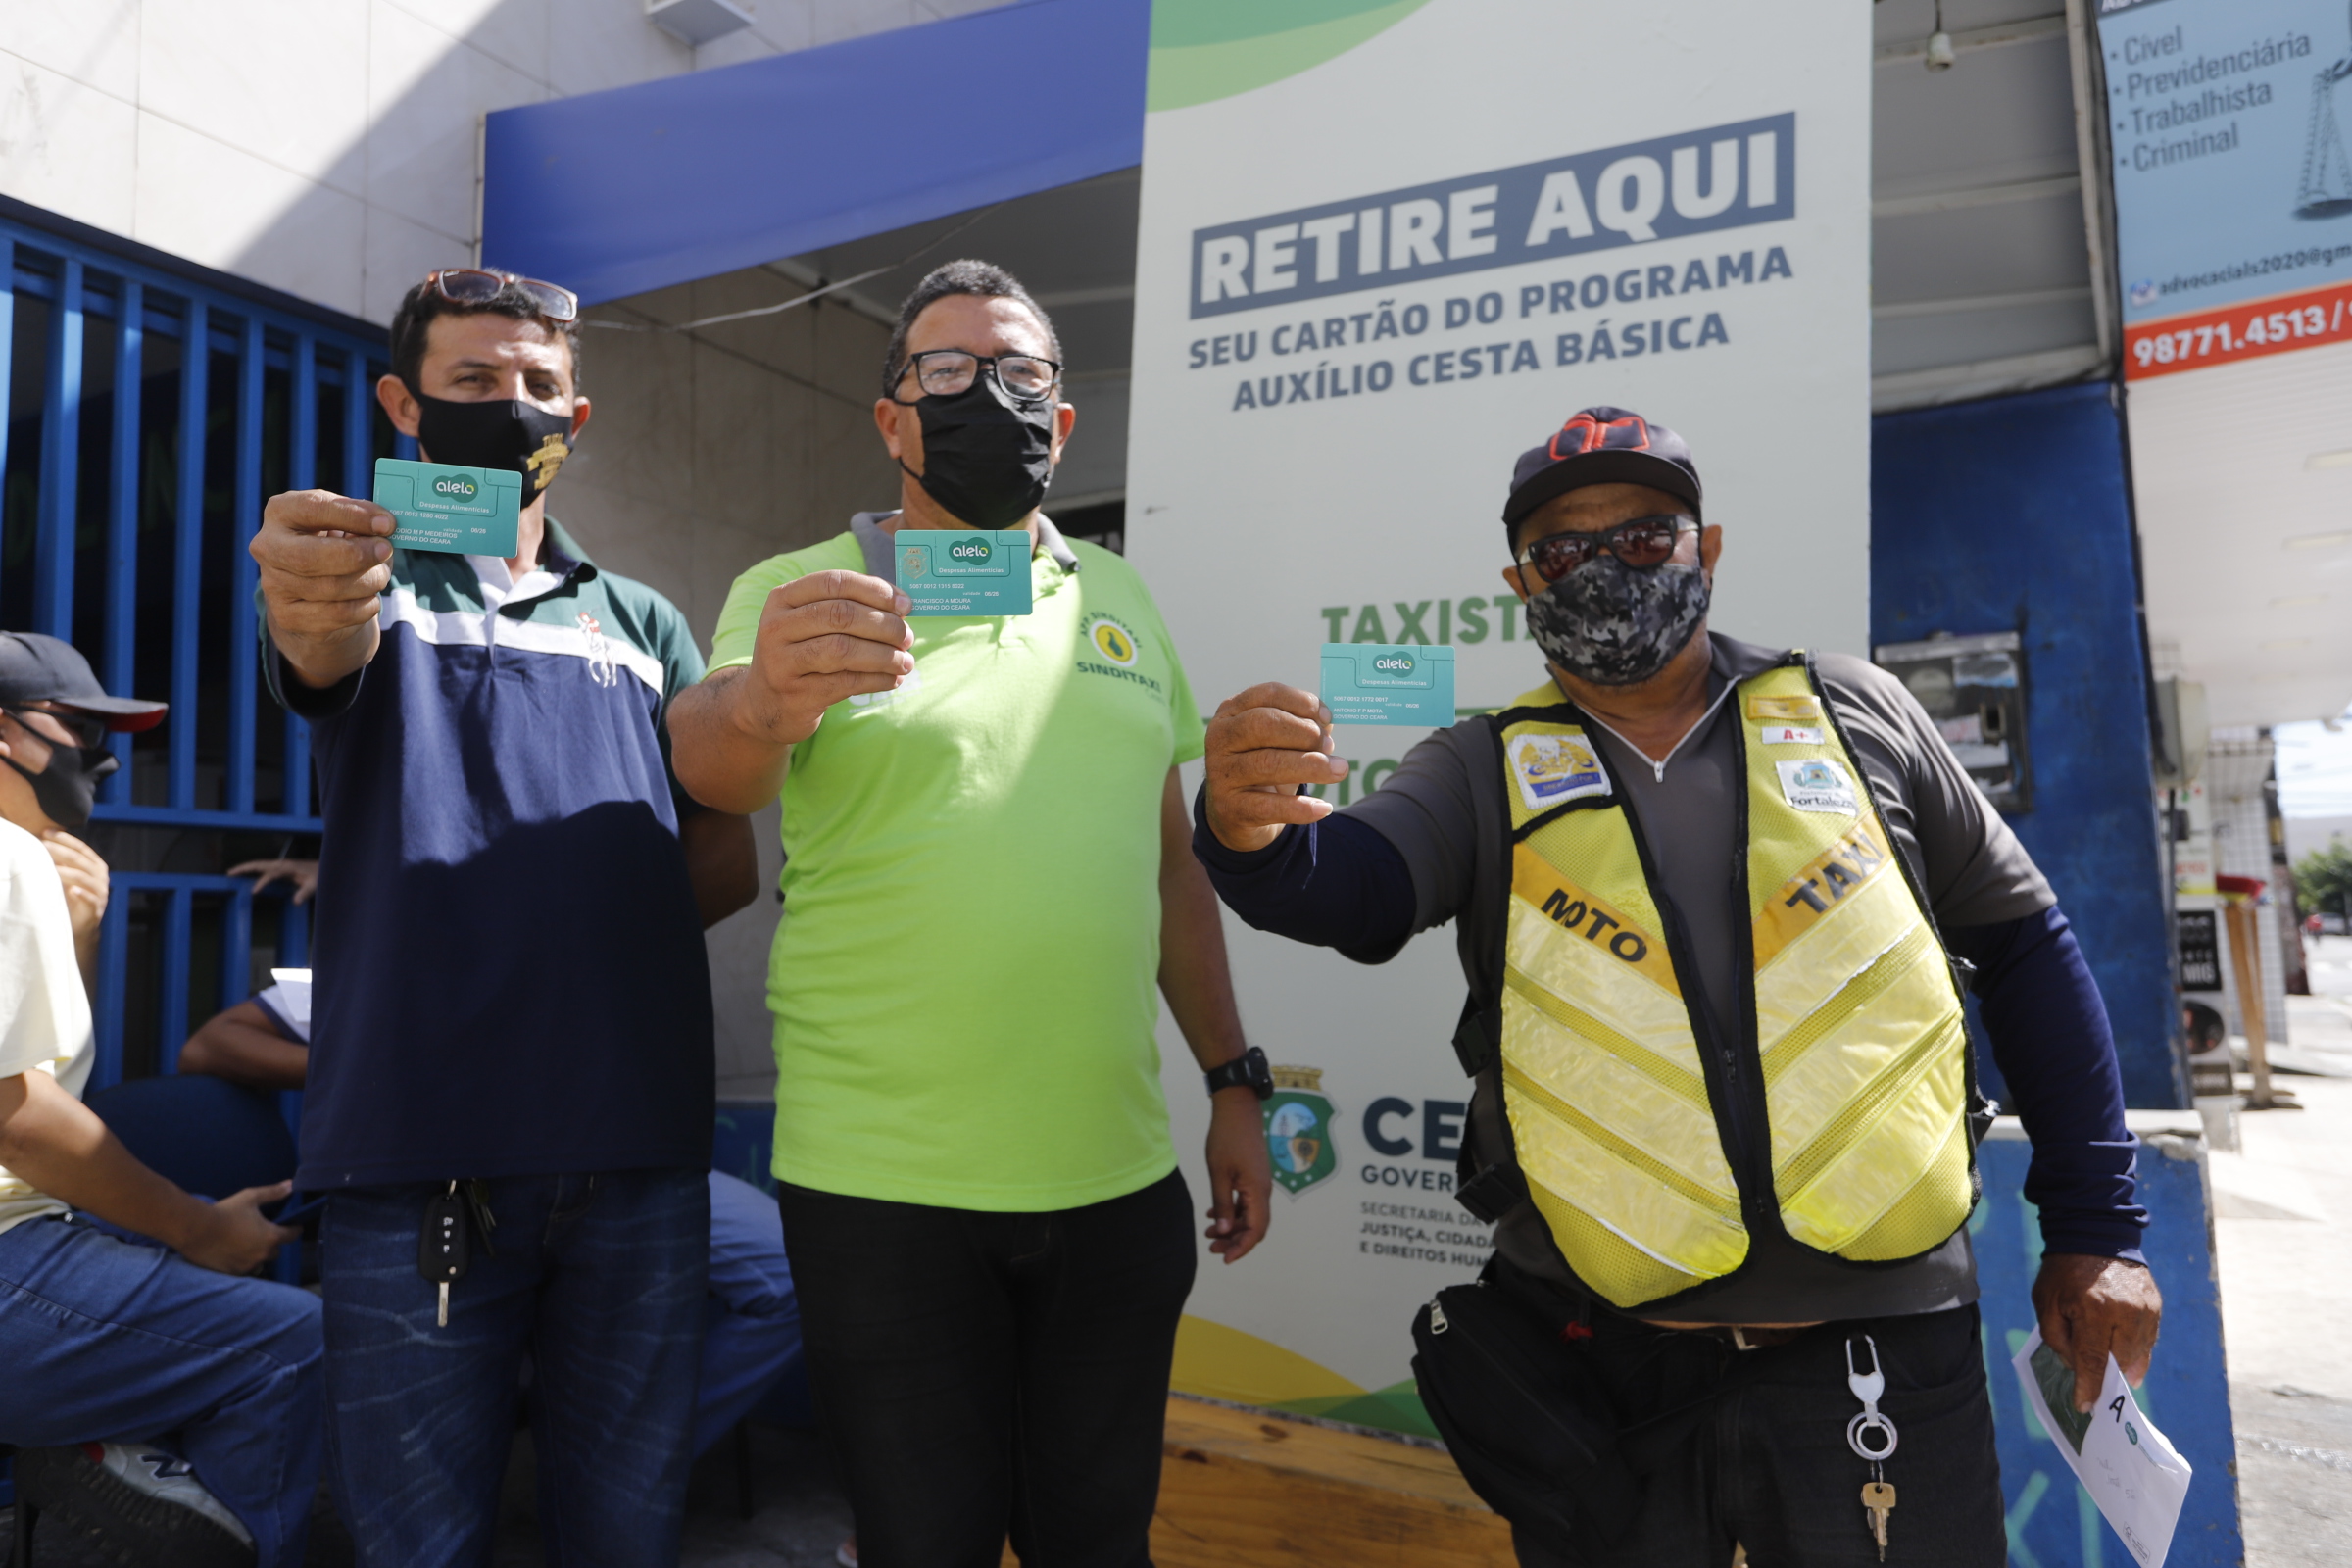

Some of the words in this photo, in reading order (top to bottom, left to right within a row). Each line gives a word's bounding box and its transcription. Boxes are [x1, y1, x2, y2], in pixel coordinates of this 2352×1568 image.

[2124, 24, 2183, 66] Cível
[2128, 30, 2311, 100] Previdenciária
[2132, 81, 2272, 135] Trabalhista
[2133, 122, 2239, 172] Criminal
[1200, 184, 1499, 304] RETIRE
[1524, 130, 1777, 243] AQUI
[2160, 244, 2352, 295] advocacials2020@gm
[1189, 329, 1257, 369] SEU
[1271, 299, 1429, 356] CARTÃO
[1444, 290, 1504, 330] DO
[1519, 245, 1794, 318] PROGRAMA
[2133, 305, 2326, 368] 98771.4513
[1231, 360, 1394, 412] AUXÍLIO
[1408, 338, 1541, 386] CESTA
[1556, 312, 1730, 367] BÁSICA
[419, 501, 450, 512] Despesas
[436, 480, 474, 495] alelo
[424, 530, 458, 539] MEDEIROS
[953, 545, 989, 557] alelo
[1321, 595, 1537, 646] TAXIST
[1376, 659, 1412, 669] alelo
[1784, 729, 1809, 740] A+
[1785, 832, 1884, 914] TAXI
[1540, 888, 1647, 962] MOTO
[1362, 1097, 1465, 1161] CE
[1361, 1165, 1458, 1193] GOVER
[1359, 1222, 1431, 1243] JUSTIÇA,
[1435, 1231, 1496, 1250] CIDADA
[1360, 1201, 1454, 1224] SECRETARIA
[1360, 1241, 1370, 1253] E
[1374, 1243, 1446, 1262] DIREITOS
[1451, 1252, 1489, 1267] HUM
